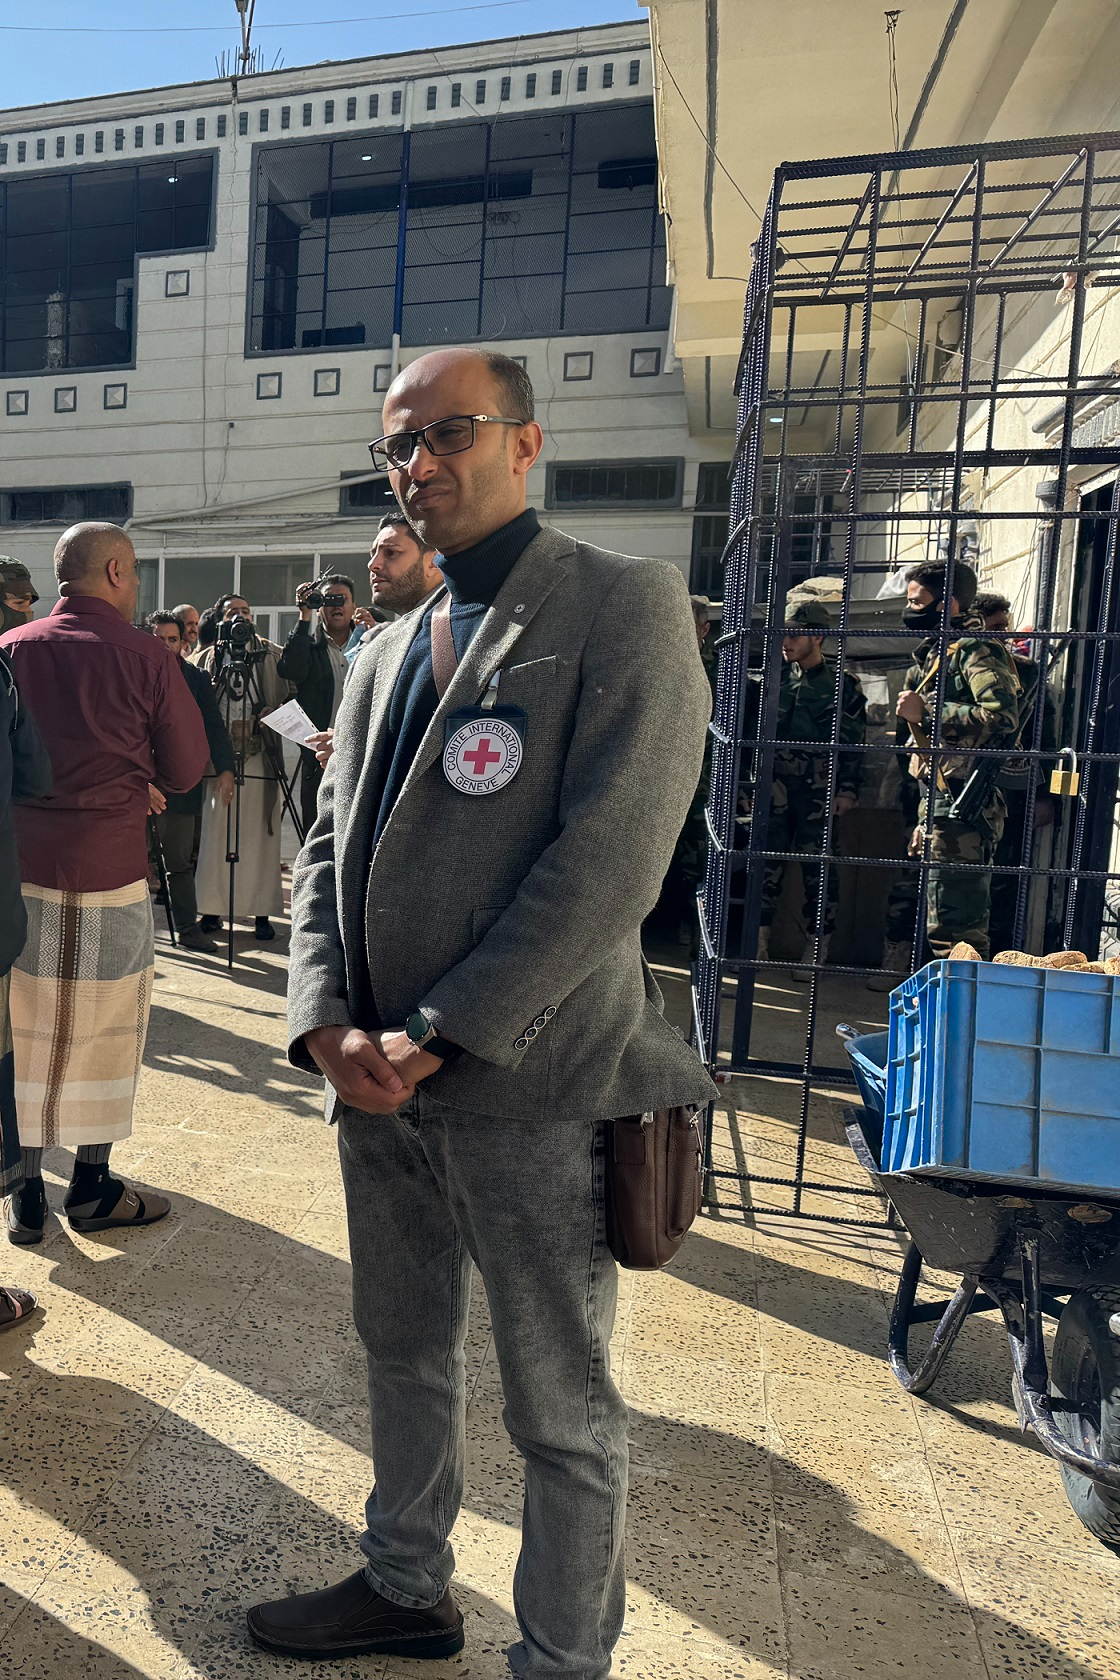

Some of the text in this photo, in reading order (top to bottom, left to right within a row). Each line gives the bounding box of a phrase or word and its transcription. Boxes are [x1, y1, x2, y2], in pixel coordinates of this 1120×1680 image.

[447, 723, 518, 774] COMITE INTERNATIONAL
[455, 777, 499, 791] GENEVE
